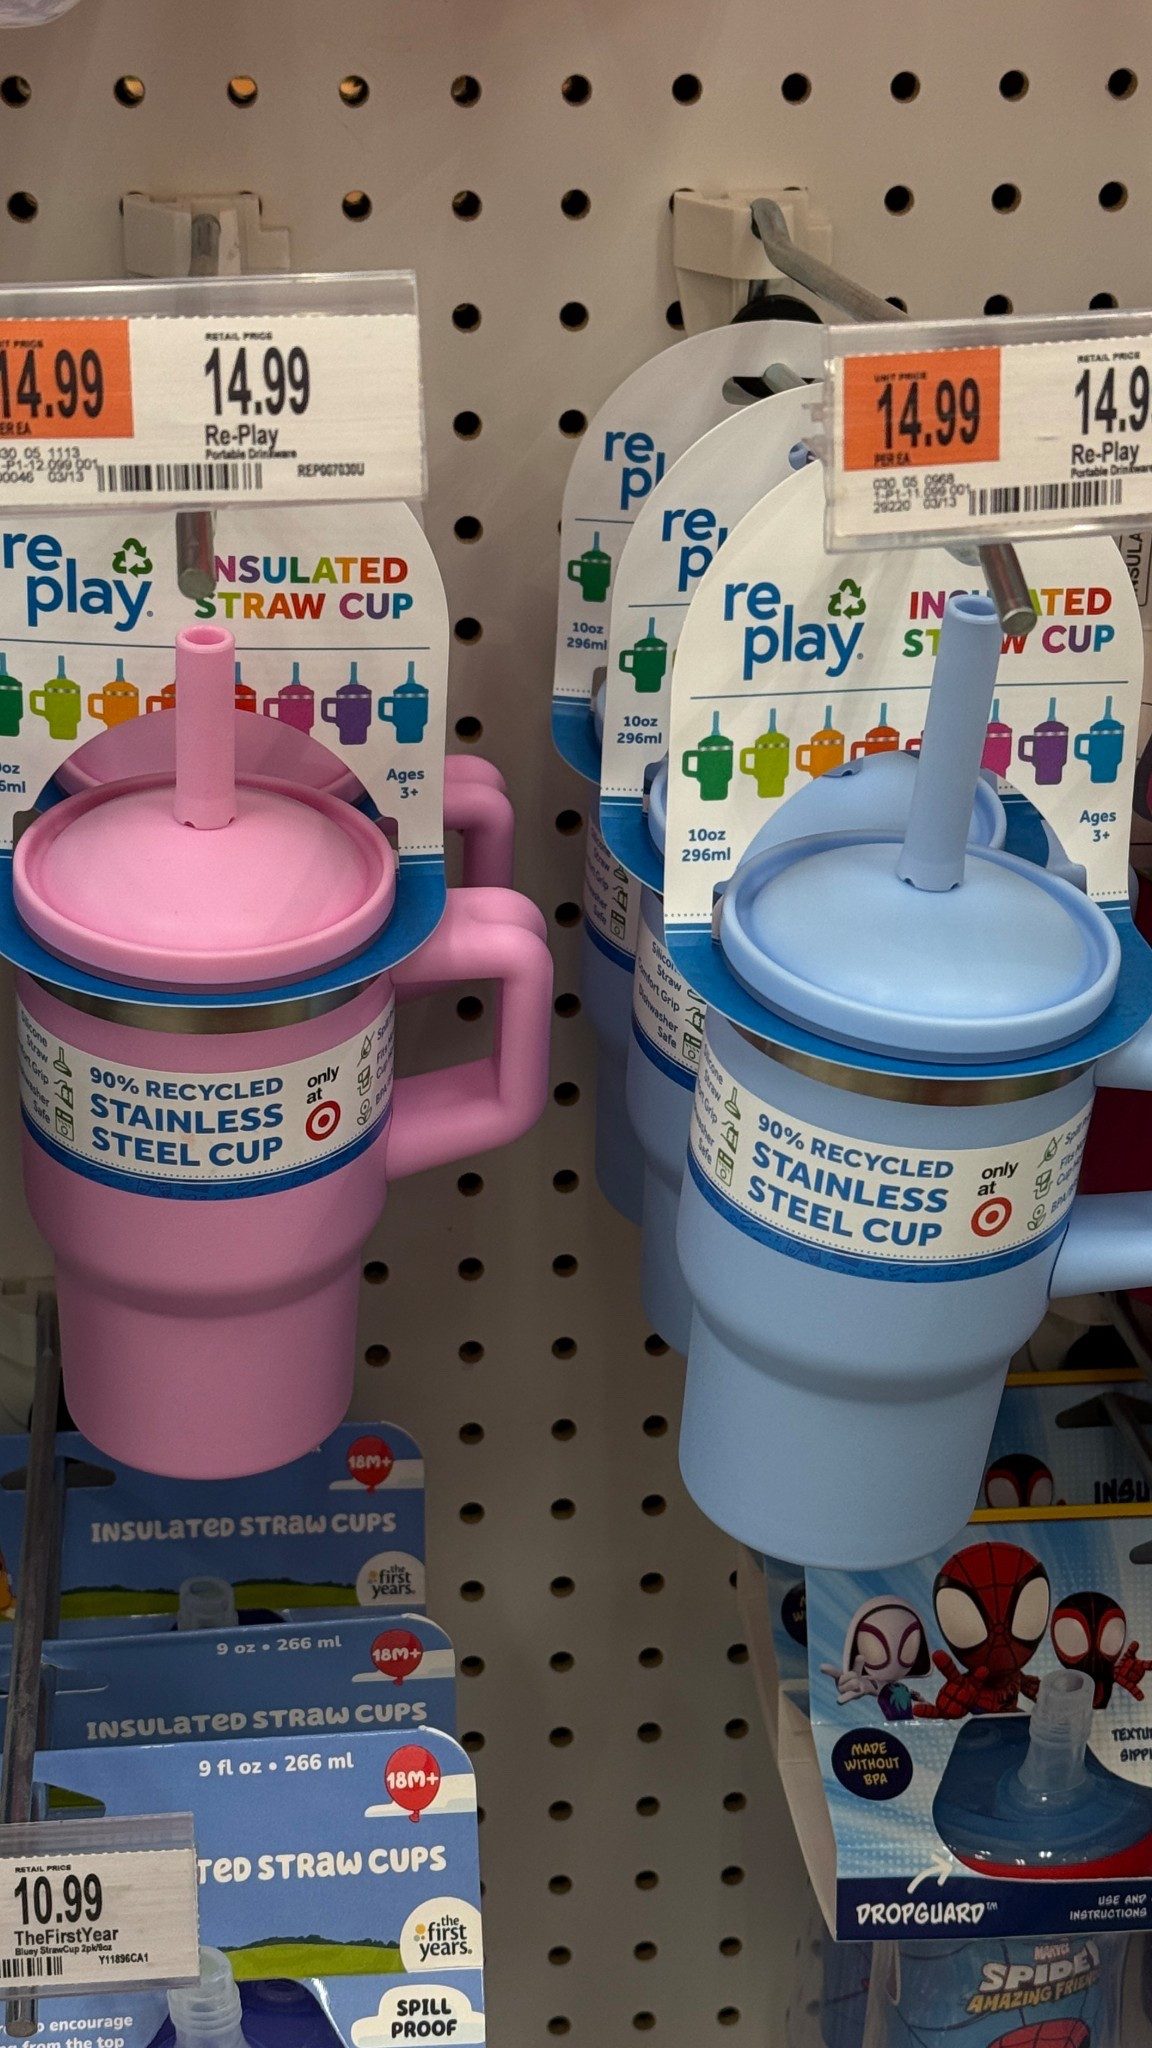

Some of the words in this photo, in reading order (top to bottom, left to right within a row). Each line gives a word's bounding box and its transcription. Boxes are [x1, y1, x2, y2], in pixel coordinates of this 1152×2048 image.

[205, 332, 240, 341] RETAIL
[243, 331, 273, 340] PRICE
[1077, 354, 1110, 363] RETAIL
[1112, 351, 1140, 360] PRICE
[0, 348, 104, 419] 14.99
[205, 346, 310, 416] 14.99
[1075, 365, 1152, 435] 14.9
[877, 378, 980, 449] 14.99
[205, 424, 279, 450] Re-Play
[205, 449, 246, 460] Portable
[604, 430, 654, 463] re
[1071, 441, 1139, 466] Re-Play
[1070, 467, 1108, 478] Portable
[662, 508, 717, 542] re
[3, 533, 62, 571] re
[213, 555, 408, 585] NSULATED
[194, 592, 326, 620] STRAW
[339, 592, 414, 620] CUP
[723, 582, 781, 621] re
[572, 622, 604, 635] 10oz
[566, 638, 608, 651] 296ml
[902, 624, 1027, 658] STW
[1042, 624, 1115, 653] CUP
[623, 716, 658, 728] 10oz
[617, 732, 662, 745] 296ml
[0, 762, 20, 774] oz
[386, 767, 425, 784] Ages
[400, 786, 418, 799] 3+
[1079, 810, 1117, 826] Ages
[688, 829, 726, 842] 10oz
[1092, 829, 1110, 842] 3+
[682, 848, 731, 862] 296ml
[657, 964, 681, 992] Straw
[657, 1026, 677, 1049] Safe
[90, 1067, 139, 1095] 90%
[146, 1077, 283, 1101] RECYCLED
[307, 1066, 339, 1088] only
[307, 1088, 322, 1104] at
[90, 1093, 283, 1134] STAINLESS
[92, 1126, 200, 1166] STEEL
[209, 1136, 283, 1166] CUP
[758, 1114, 805, 1150] 90%
[811, 1137, 954, 1178] RECYCLED
[752, 1141, 949, 1213] STAINLESS
[981, 1161, 1019, 1179] only
[977, 1181, 997, 1196] at
[748, 1175, 853, 1237] STEEL
[863, 1218, 942, 1246] CUP
[348, 1454, 392, 1469] 18M+
[331, 1512, 397, 1533] CUPS
[379, 1569, 411, 1585] first
[390, 1564, 406, 1574] the
[216, 1642, 229, 1656] 9
[234, 1643, 256, 1655] oz
[276, 1637, 312, 1651] 266
[317, 1635, 343, 1649] ml
[371, 1648, 422, 1662] 18M+
[355, 1701, 428, 1723] CUPS
[1112, 1727, 1152, 1742] TEXTU
[852, 1742, 887, 1756] MADE
[1120, 1747, 1152, 1762] SIPP
[199, 1760, 212, 1777] 9
[217, 1759, 234, 1776] fl
[239, 1761, 263, 1775] oz
[284, 1754, 322, 1772] 266
[327, 1752, 355, 1770] ml
[844, 1757, 900, 1771] WITHOUT
[386, 1770, 439, 1790] 18M+
[863, 1772, 888, 1785] BPA
[15, 1865, 45, 1873] RETAIL
[47, 1864, 71, 1872] PRICE
[368, 1845, 447, 1875] CUPS
[14, 1873, 102, 1925] 10.99
[1098, 1895, 1120, 1906] USE
[1125, 1894, 1147, 1904] AND
[441, 1914, 459, 1926] the
[1070, 1907, 1147, 1920] INSTRUCTIONS
[14, 1927, 119, 1946] TheFirstYear
[428, 1922, 467, 1941] first
[15, 1948, 38, 1957] Bluey
[397, 1998, 451, 2016] SPILL
[967, 1986, 1051, 2013] AMAZING
[49, 2016, 133, 2031] encourage
[391, 2019, 457, 2038] PROOF
[66, 2037, 92, 2048] the
